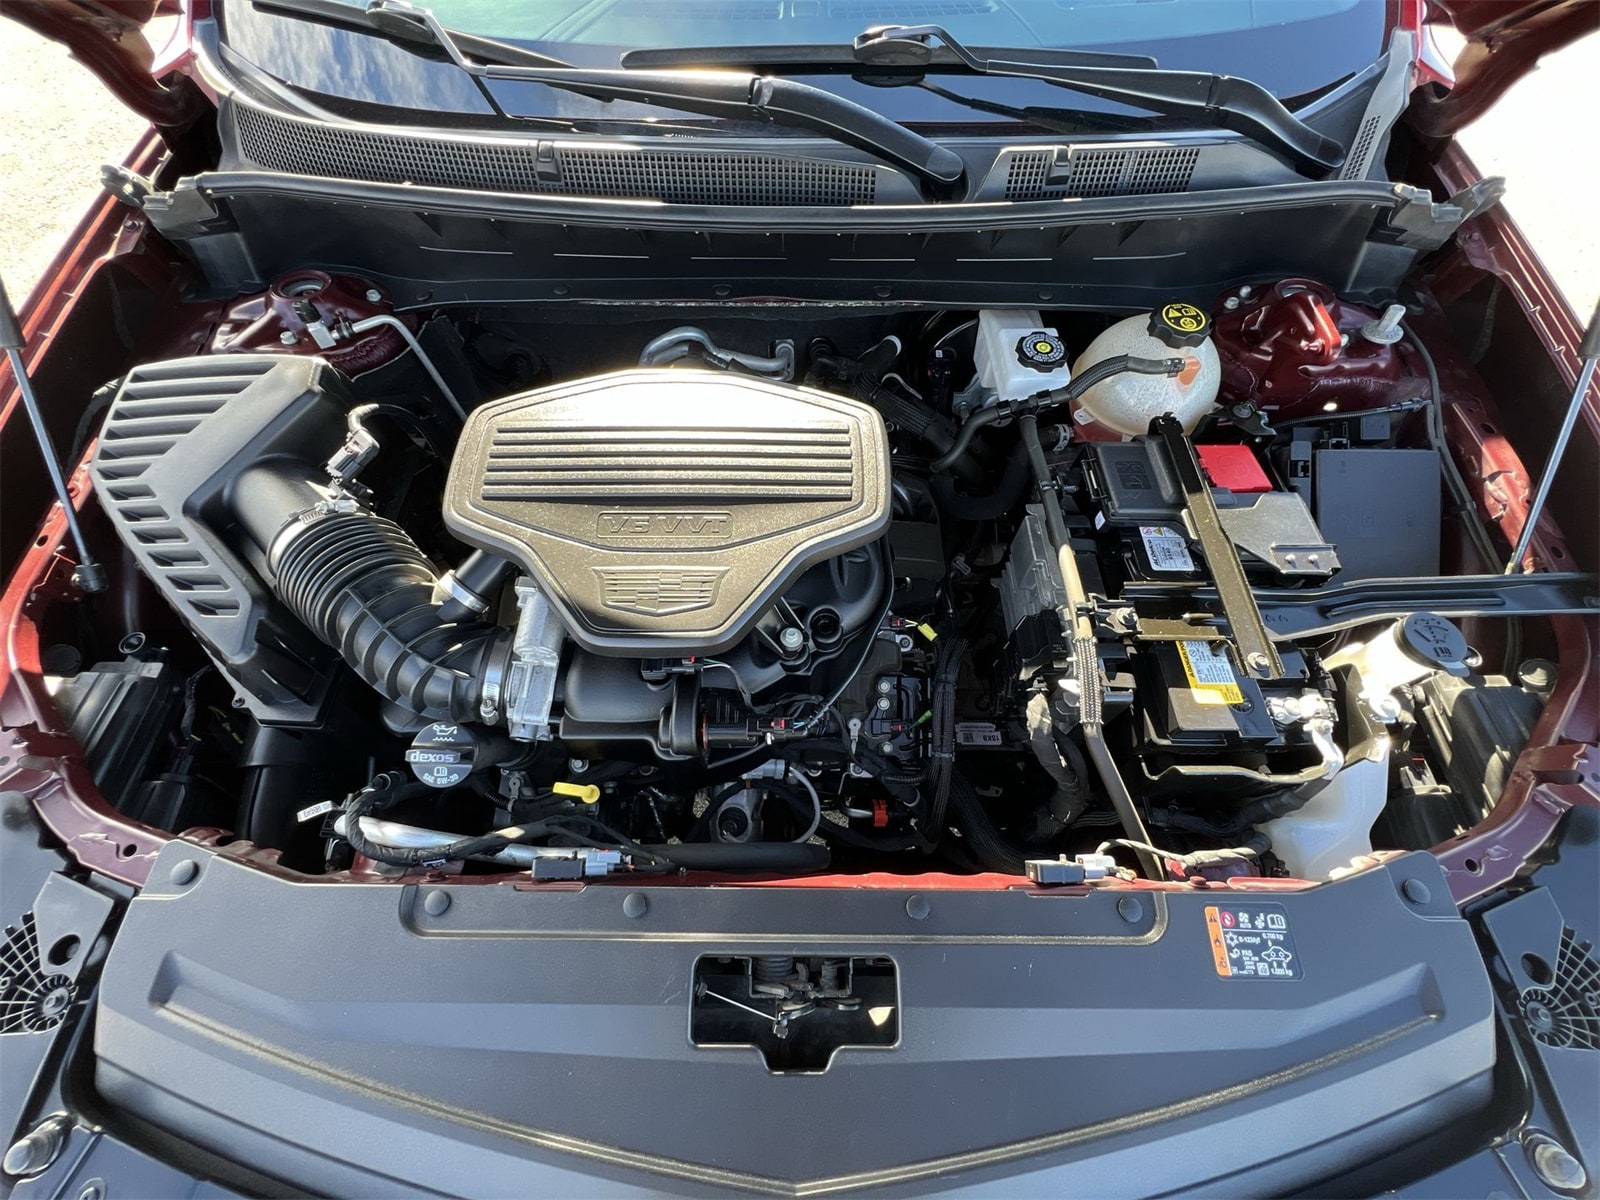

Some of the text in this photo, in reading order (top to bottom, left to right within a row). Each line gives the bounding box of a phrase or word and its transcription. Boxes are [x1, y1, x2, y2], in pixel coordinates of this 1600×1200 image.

[603, 515, 728, 534] V6 VVT
[410, 751, 456, 763] dexos
